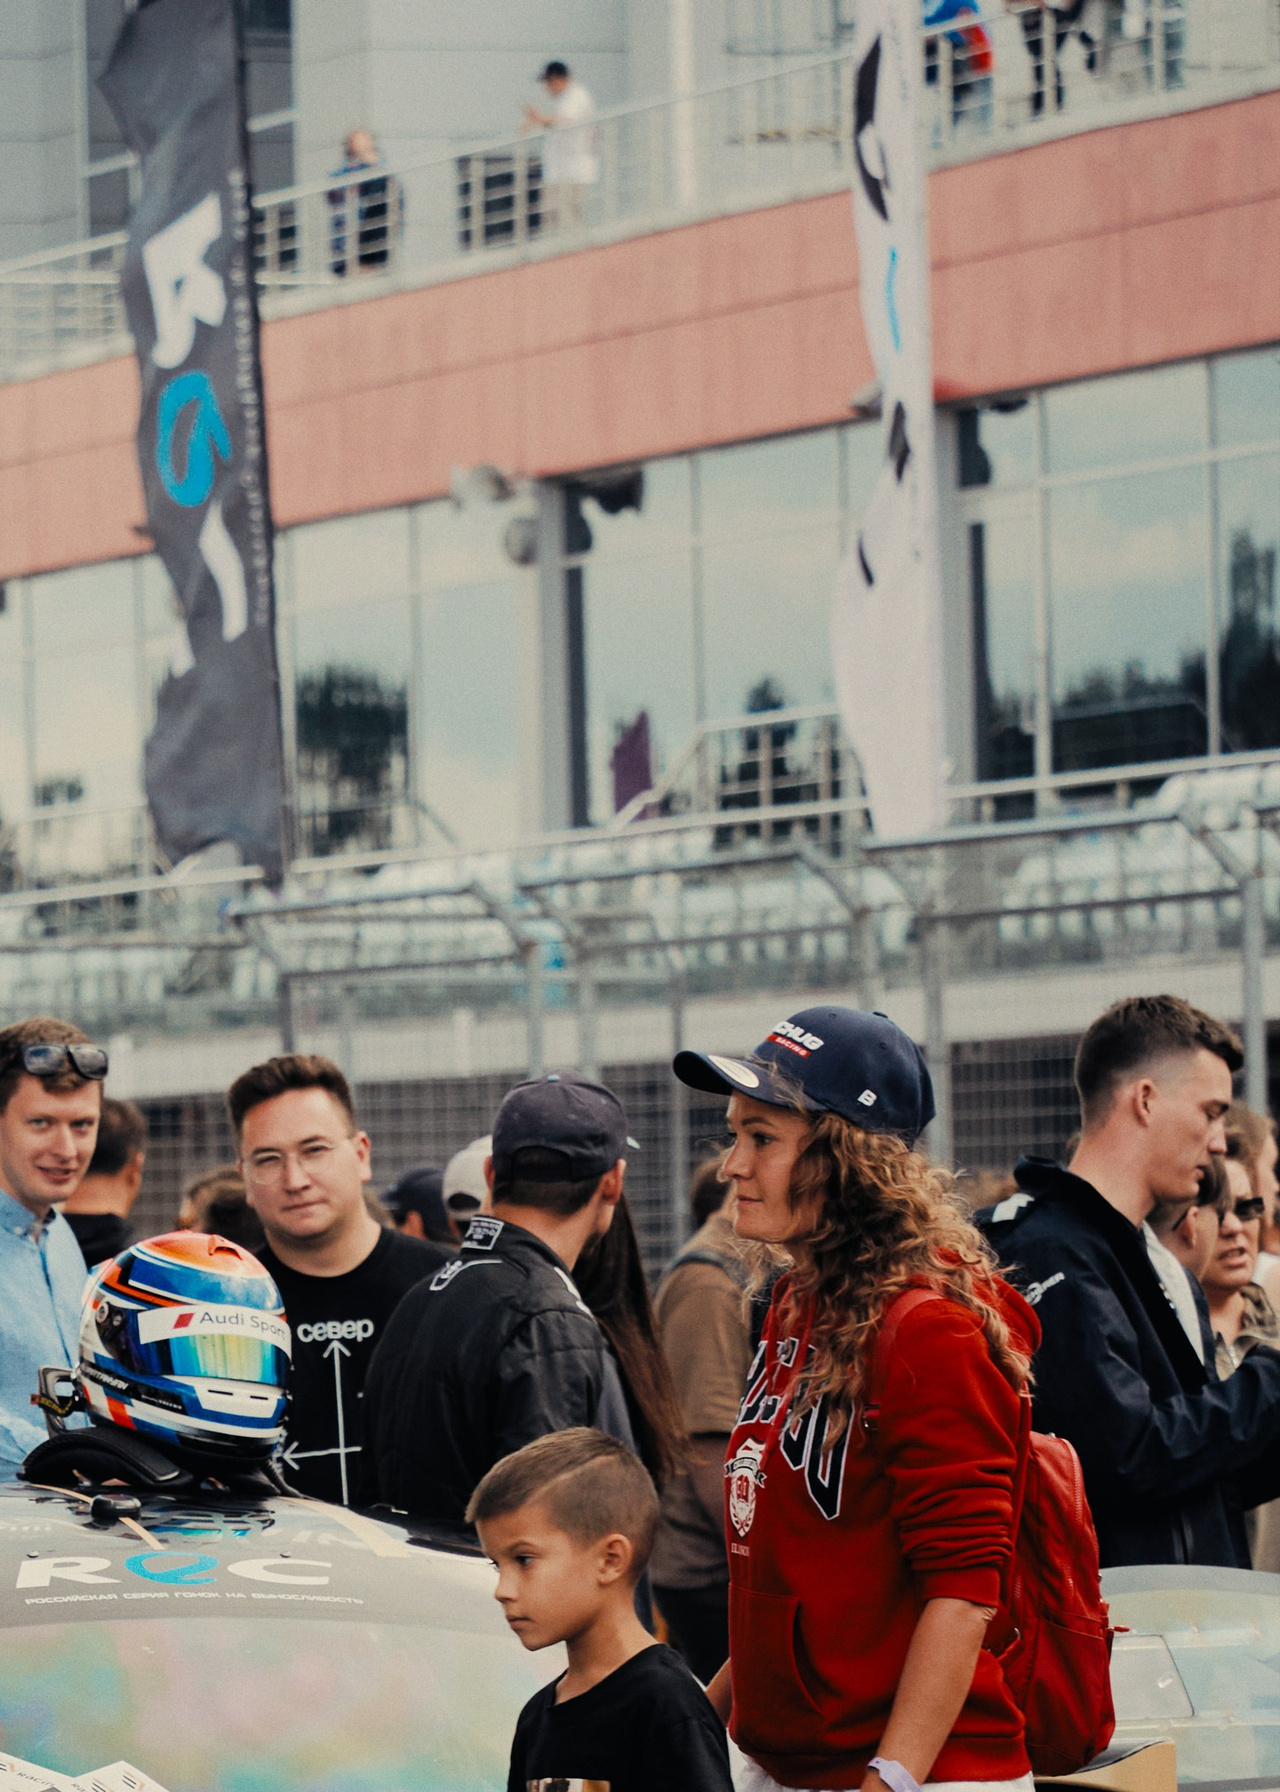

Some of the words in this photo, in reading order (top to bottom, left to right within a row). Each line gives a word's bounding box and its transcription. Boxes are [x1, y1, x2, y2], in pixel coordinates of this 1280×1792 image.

[857, 1089, 877, 1107] B
[200, 1312, 244, 1324] Audi
[250, 1315, 286, 1341] Sport
[25, 1593, 118, 1605] РОССИЙСКАЯ
[174, 1591, 221, 1599] ГОНОК
[251, 1592, 365, 1604] ВЫНОСЛИВОСТЬ
